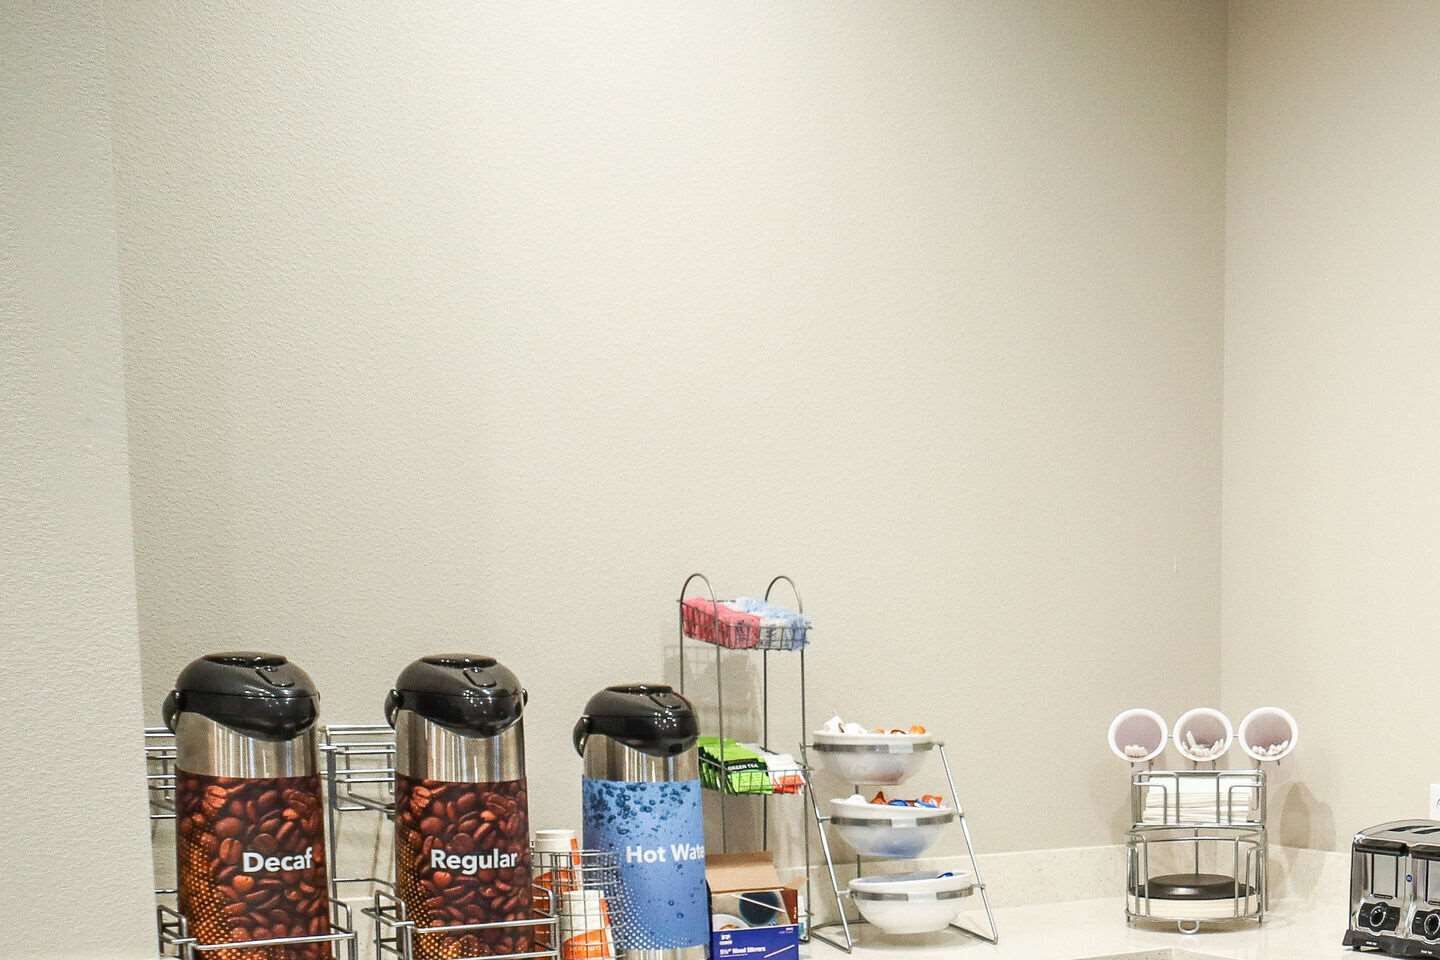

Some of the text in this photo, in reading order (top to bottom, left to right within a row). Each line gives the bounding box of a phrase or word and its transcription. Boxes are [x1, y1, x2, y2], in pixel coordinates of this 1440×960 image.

[243, 847, 314, 874] Decaf
[430, 848, 518, 876] Regular
[625, 842, 705, 864] Hot Wate
